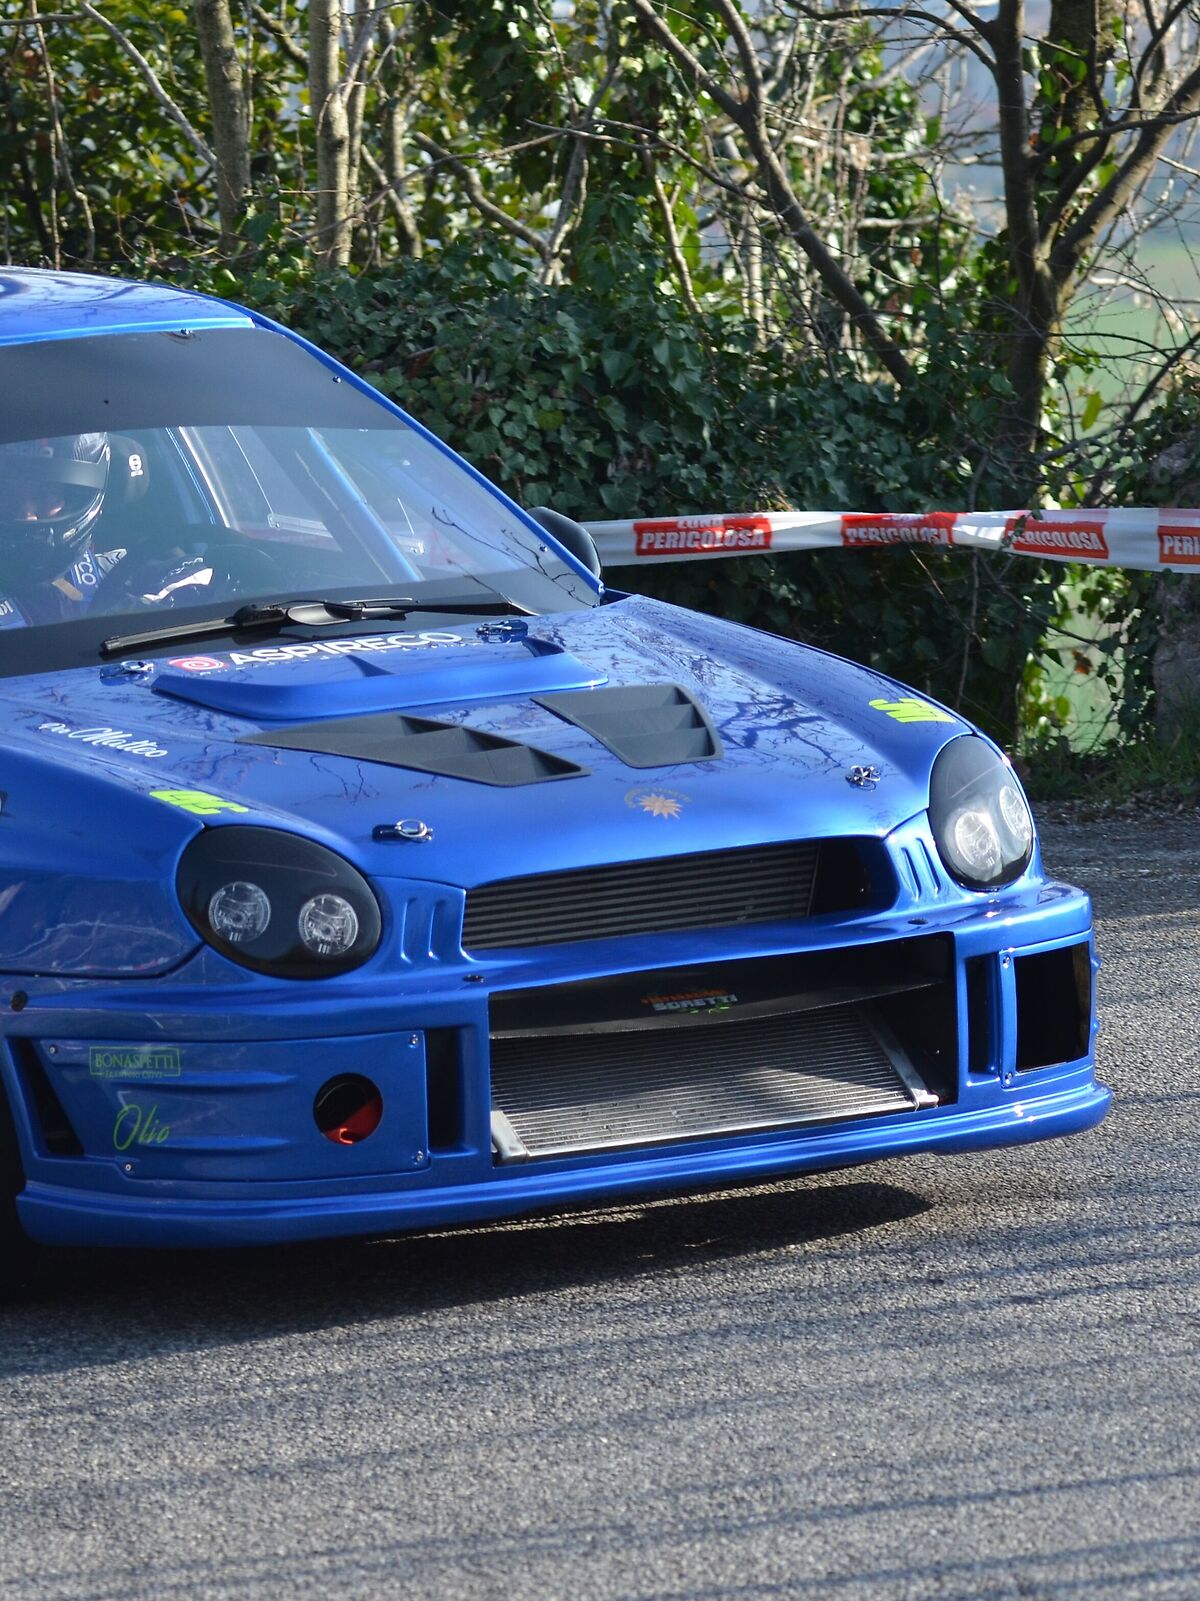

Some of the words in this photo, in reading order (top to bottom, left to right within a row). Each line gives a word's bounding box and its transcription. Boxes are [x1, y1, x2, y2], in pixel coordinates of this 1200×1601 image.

[640, 528, 766, 550] PERICOLOSA
[1163, 534, 1200, 556] PERI
[228, 632, 463, 666] ASPIRECO
[113, 1104, 171, 1151] Olio
